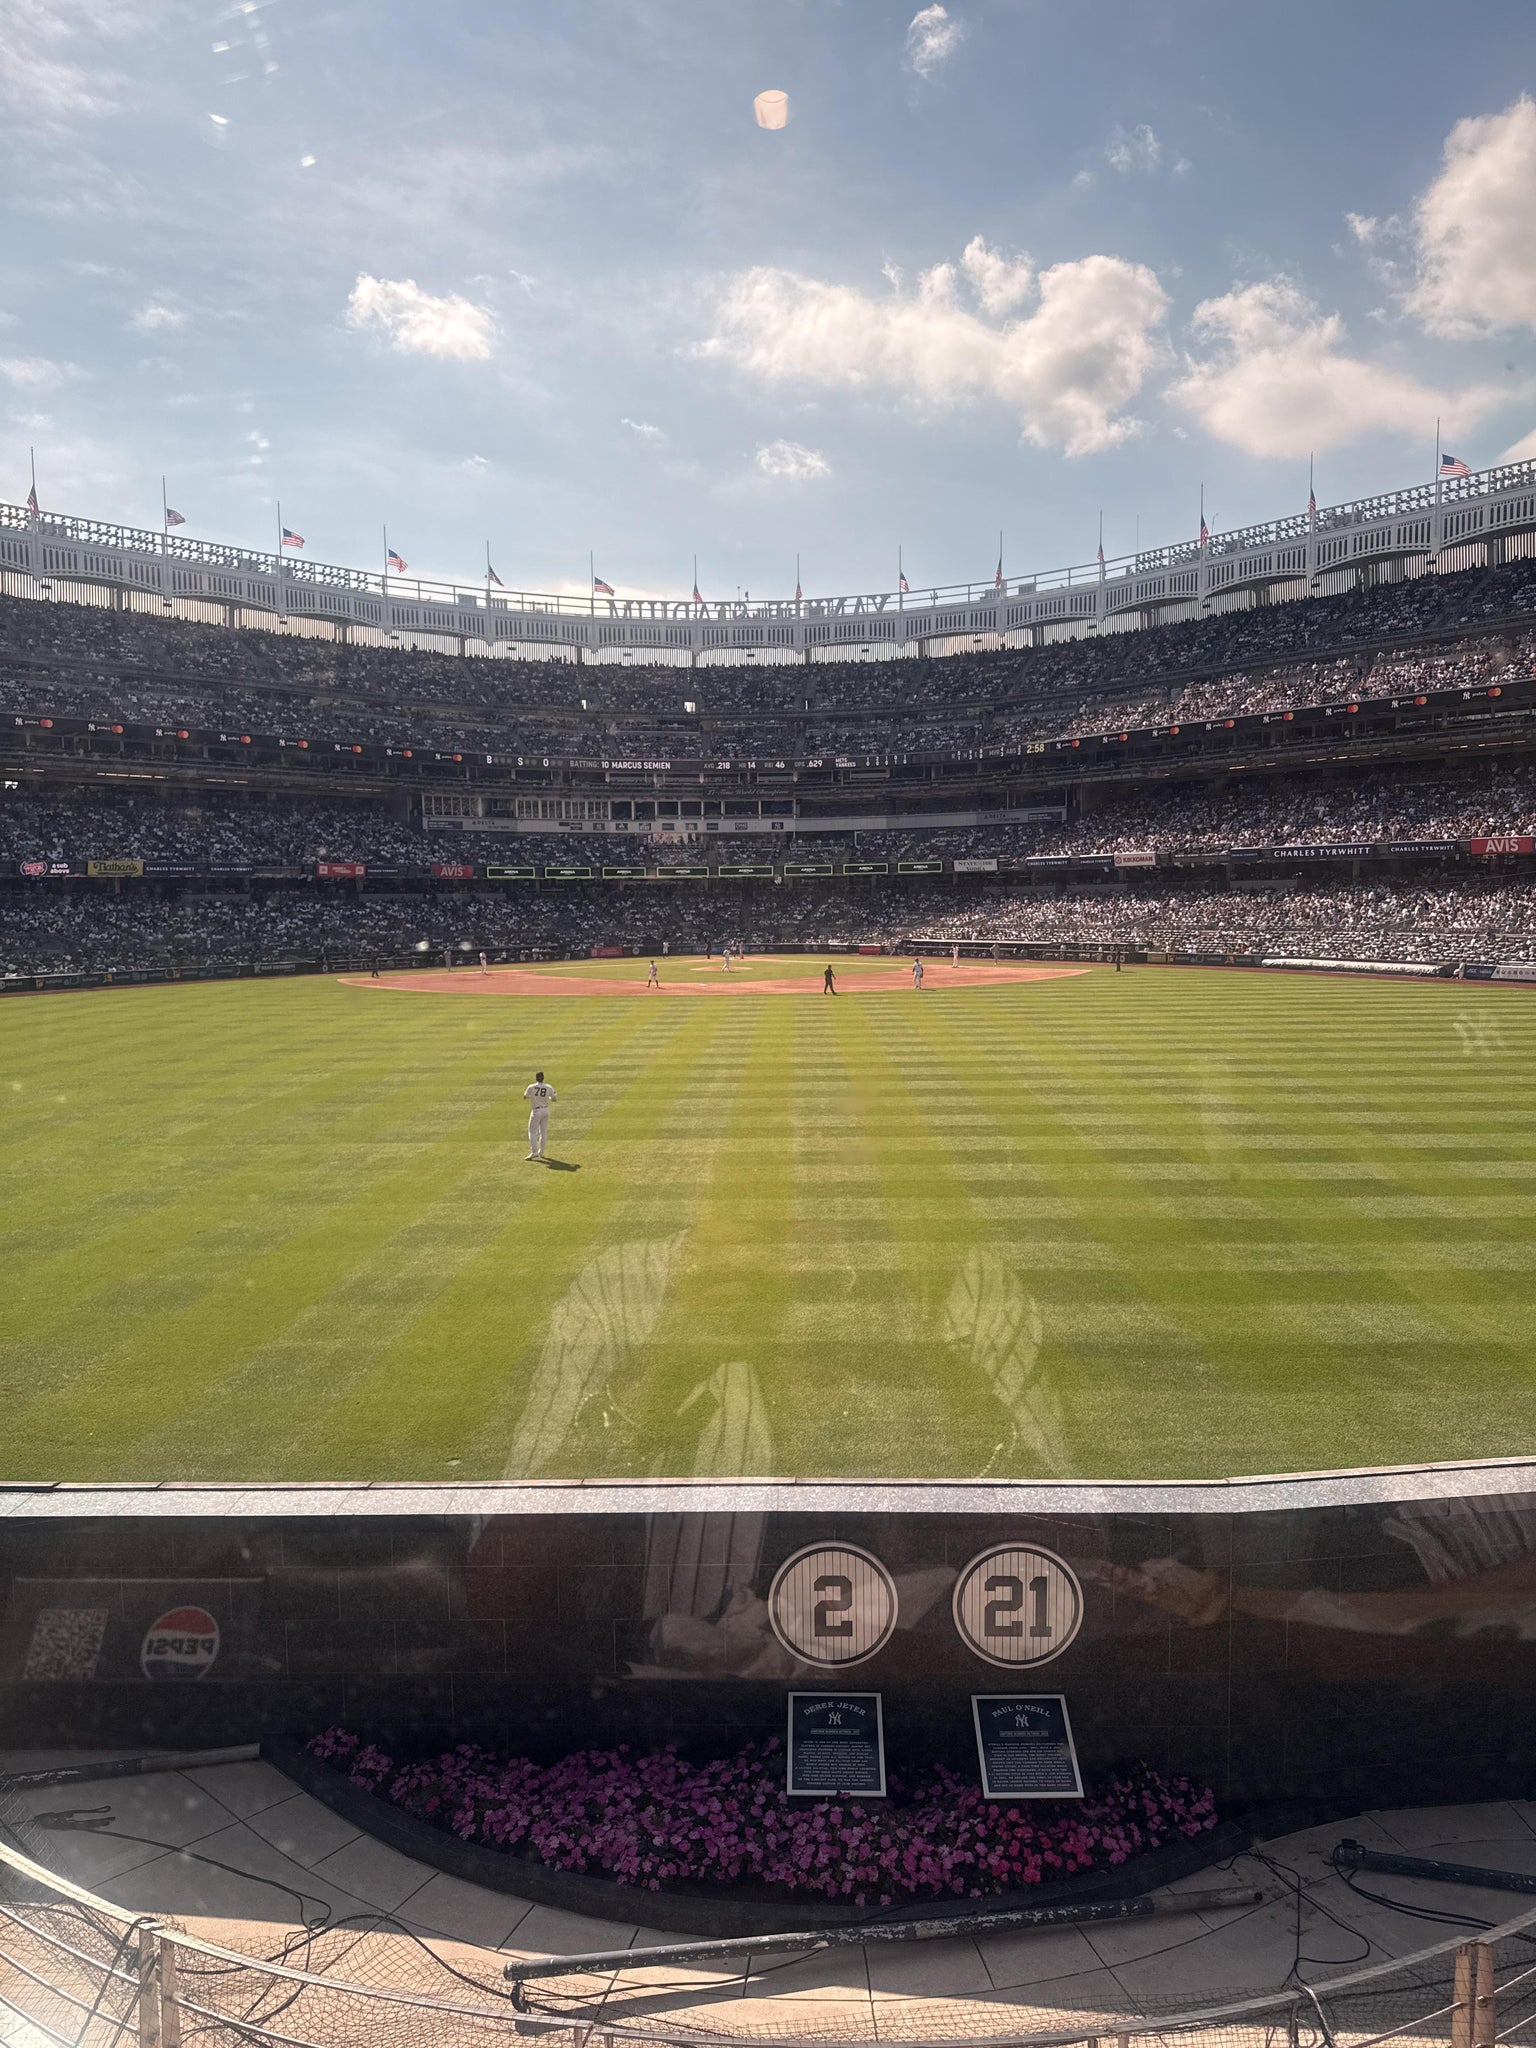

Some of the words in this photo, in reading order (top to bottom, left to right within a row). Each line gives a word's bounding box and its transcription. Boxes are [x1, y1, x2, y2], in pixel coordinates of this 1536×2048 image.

[1026, 744, 1045, 754] 2:58
[486, 755, 492, 764] B
[517, 757, 523, 766] S
[569, 760, 599, 768] BATTING:
[601, 761, 609, 769] 10
[611, 761, 642, 769] MARCUS
[643, 761, 671, 769] SEMIEN
[806, 760, 823, 768] .629
[1485, 839, 1519, 852] AVIS
[1273, 849, 1315, 858] CHARLES
[1319, 847, 1371, 856] TYRWHITT
[93, 861, 137, 872] Nathan's
[440, 866, 464, 877] AVIS
[534, 1087, 547, 1097] 78
[814, 1575, 853, 1637] 2
[984, 1575, 1052, 1637] 21
[804, 1701, 834, 1716] DEREK
[836, 1702, 866, 1716] JETER
[991, 1705, 1014, 1718] PAUL
[1015, 1704, 1051, 1718] O'NEILL
